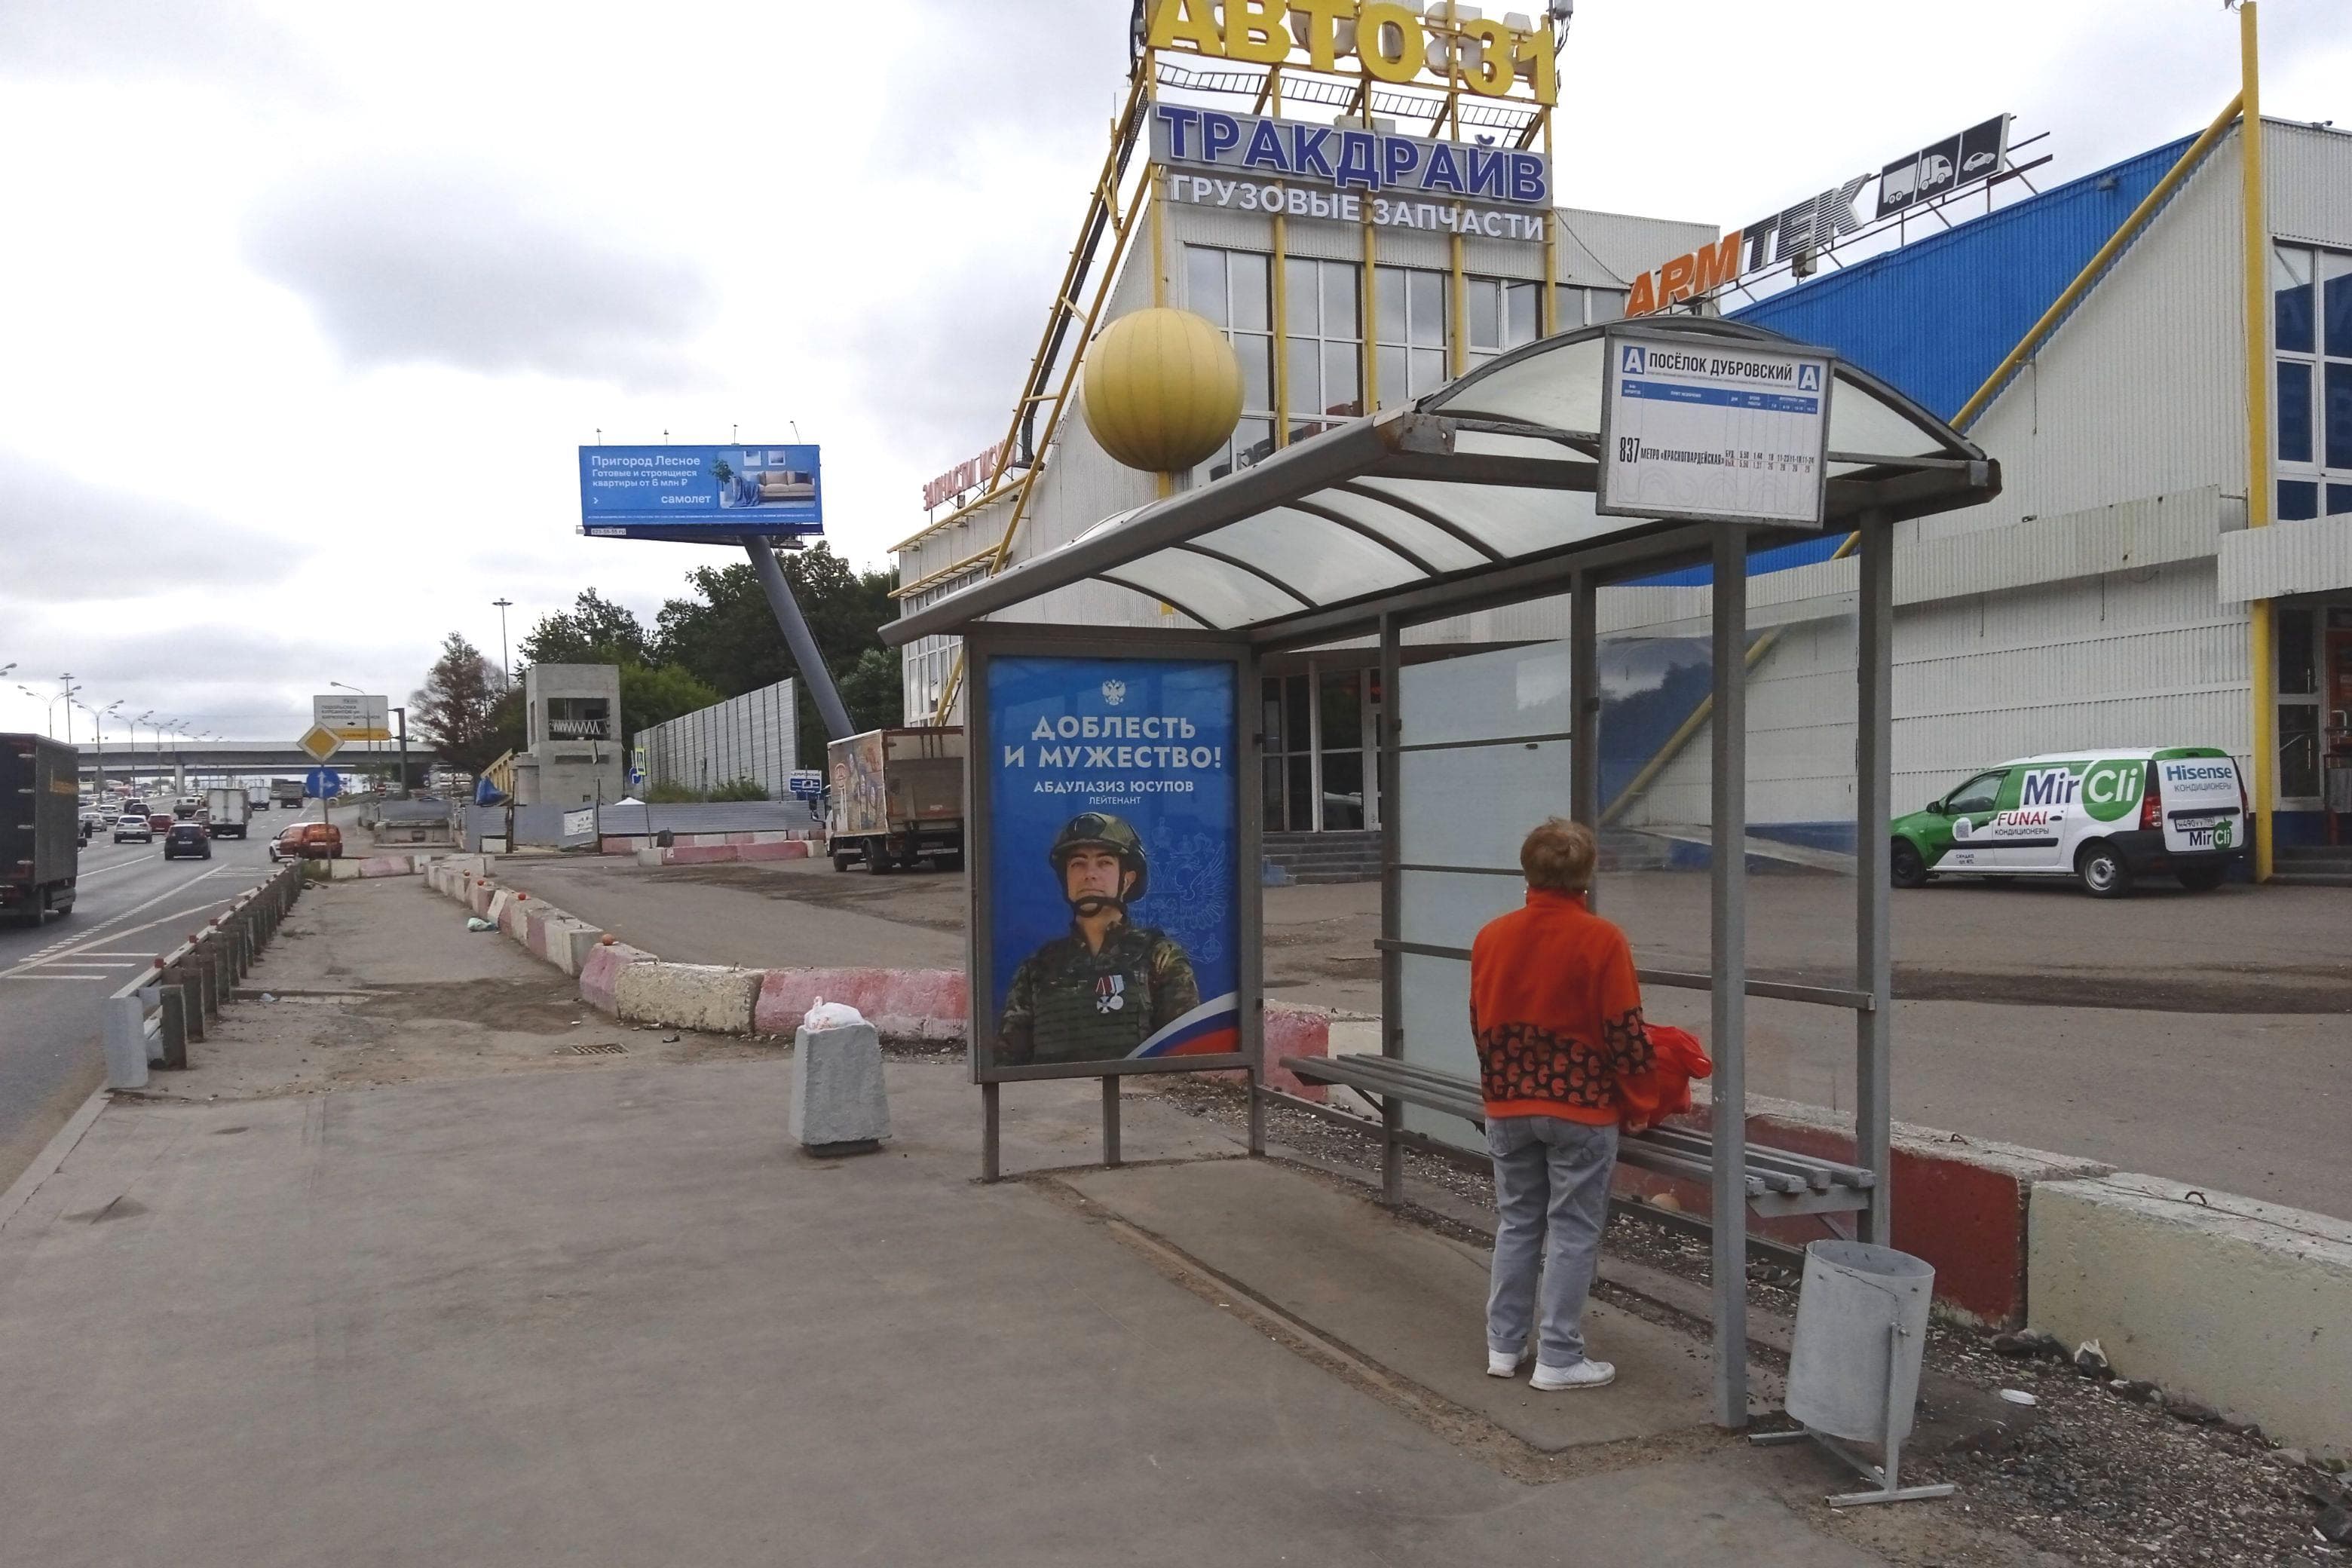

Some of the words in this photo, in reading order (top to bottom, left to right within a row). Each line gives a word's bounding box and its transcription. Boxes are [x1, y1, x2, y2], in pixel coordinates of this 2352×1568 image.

[1147, 0, 1425, 82] АВТО
[1462, 14, 1557, 106] 31
[1156, 105, 1547, 203] ТРАКДРАЙВ
[1171, 174, 1361, 222] ГРУЗОВЫЕ
[1372, 198, 1544, 241] ЗАПЧАСТИ
[1649, 353, 1707, 373] ПОСЁЛОК
[1710, 359, 1793, 381] ДУБРОВСКИЙ
[1619, 436, 1640, 463] 837
[1640, 448, 1659, 460] МЕТРО
[592, 456, 653, 467] Пригород
[655, 455, 700, 466] Лесное
[661, 495, 712, 504] самолет
[1031, 715, 1196, 740] ДОБЛЕСТЬ
[1004, 746, 1024, 767] И
[1038, 746, 1222, 768] МУЖЕСТВО!
[2167, 765, 2232, 781] Hisense
[1034, 781, 1125, 793] АБДУЛАЗИЗ
[1130, 781, 1194, 792] ЮСУПОВ
[2174, 782, 2231, 792] КОНДИЦИОНЕРЫ
[1089, 795, 1141, 804] ЛЕЙТЕНАНТ
[1998, 811, 2047, 826] FUNAI
